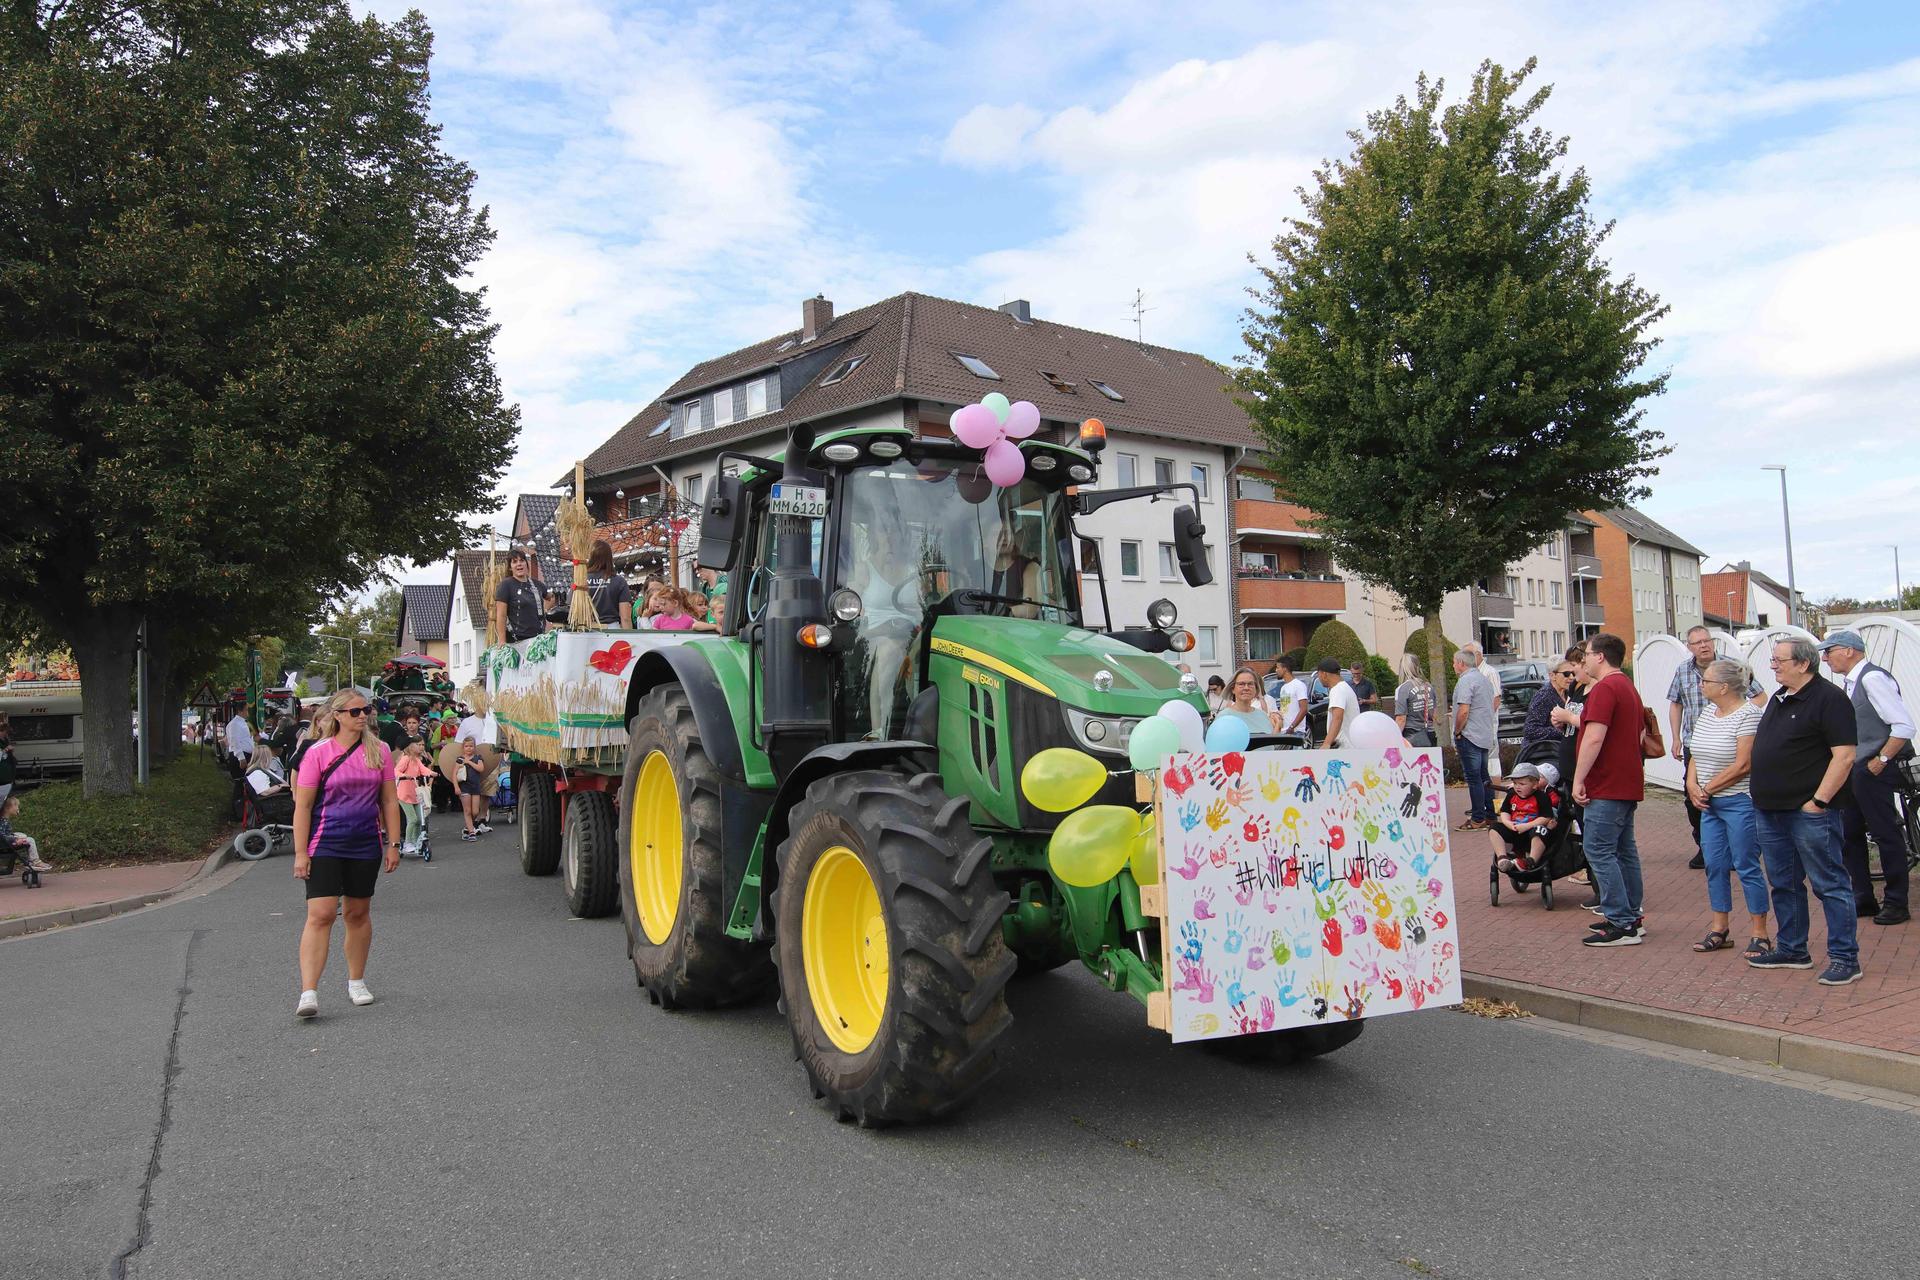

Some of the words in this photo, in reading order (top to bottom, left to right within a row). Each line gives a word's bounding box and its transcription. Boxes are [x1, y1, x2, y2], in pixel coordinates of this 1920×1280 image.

[795, 488, 804, 500] H
[772, 500, 790, 512] MM
[792, 501, 824, 515] 6120
[1535, 825, 1547, 836] 10
